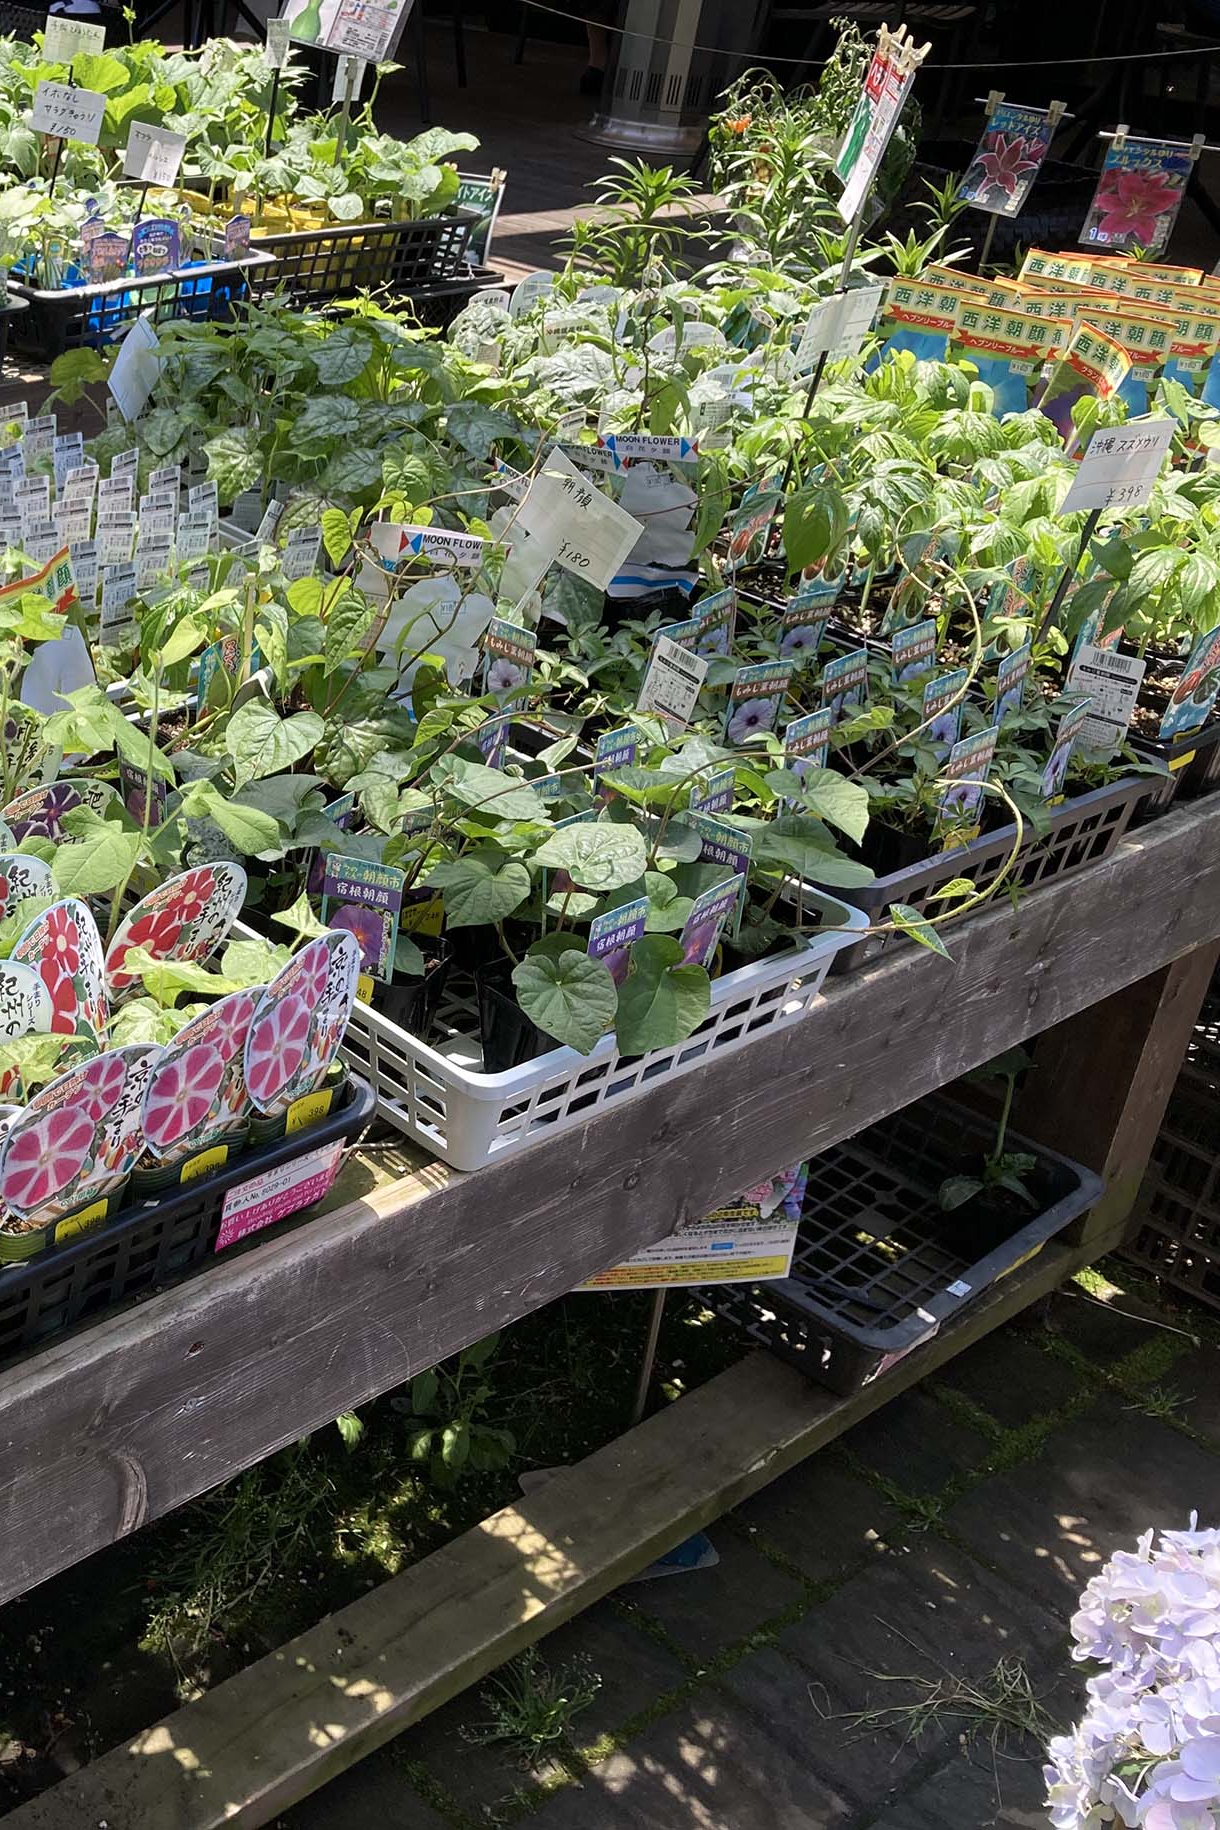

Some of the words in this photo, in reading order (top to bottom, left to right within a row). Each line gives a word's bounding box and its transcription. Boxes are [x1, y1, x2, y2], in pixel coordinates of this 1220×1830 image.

[963, 311, 1046, 341] 西洋朝顔
[615, 436, 641, 444] MOON
[642, 436, 680, 446] FLOWER
[562, 479, 592, 510] 朝顔
[1105, 485, 1143, 506] ¥398
[423, 535, 451, 546] MOON
[558, 538, 591, 567] ¥180
[336, 881, 390, 906] 宿根朝顔
[307, 1104, 325, 1118] 398
